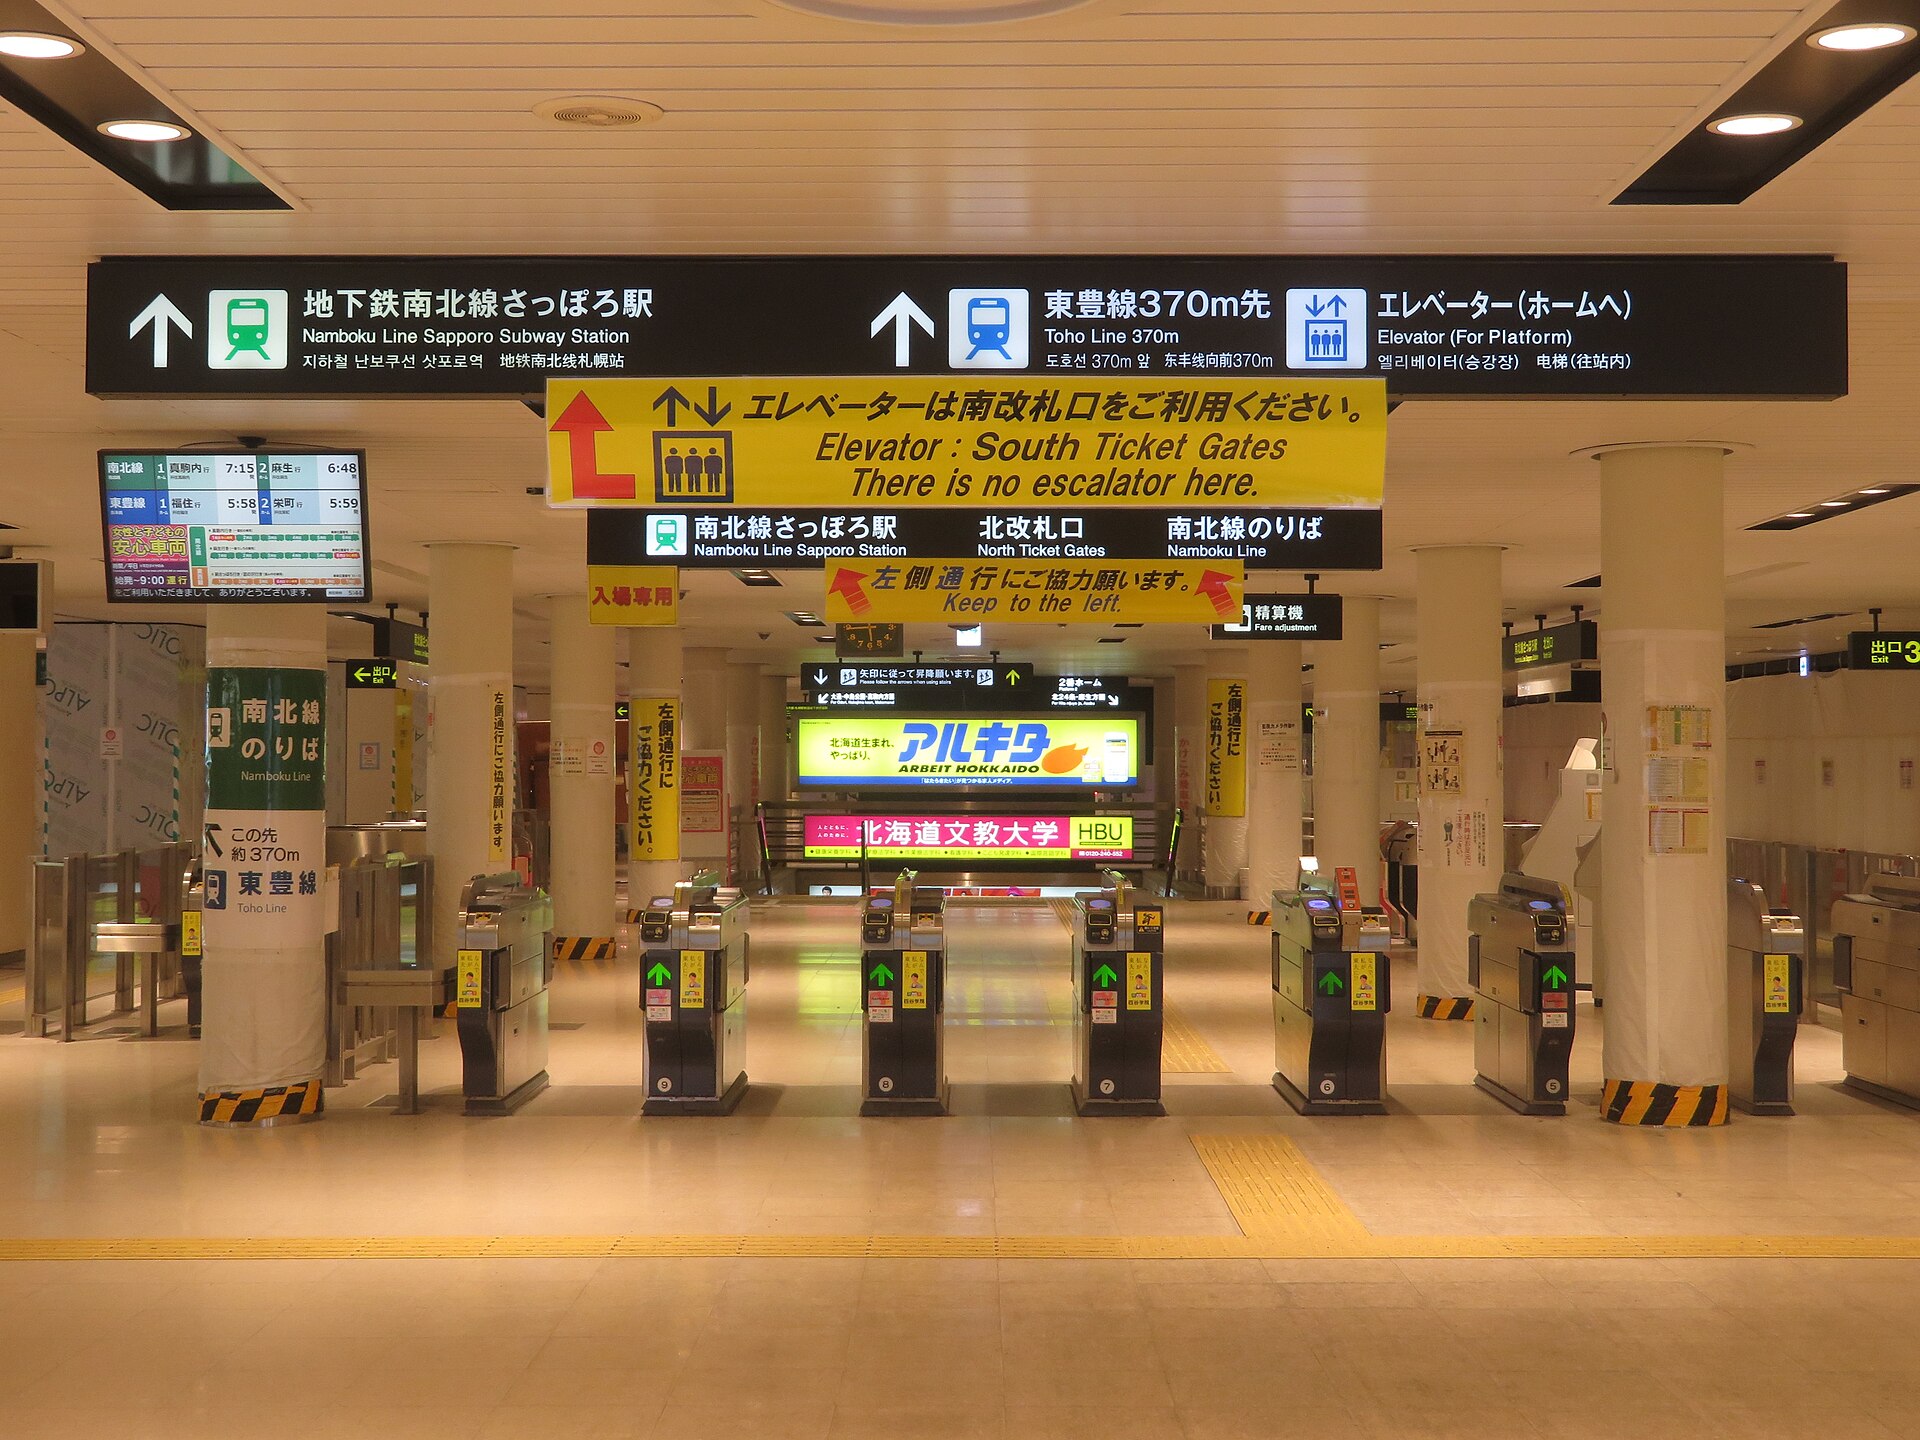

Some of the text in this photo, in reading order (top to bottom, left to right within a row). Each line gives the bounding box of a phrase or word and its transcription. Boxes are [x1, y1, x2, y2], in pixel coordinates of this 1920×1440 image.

[303, 288, 653, 319] 地下鉄南北線さっぽろ駅
[1044, 289, 1271, 319] 東豊線370m先
[1378, 290, 1631, 320] エレベーター(ホームへ)
[303, 328, 629, 347] Namboku Line Sapporo Subway Station
[1044, 328, 1179, 344] Toho Line 370m
[1378, 329, 1572, 348] Elevator (For Platform)
[302, 354, 483, 369] 지하철 난보쿠선 삿포로역
[499, 353, 625, 369] 地铁南北线札幌站
[1045, 353, 1151, 369] 도호선 370m 앞
[1164, 352, 1273, 369] 东丰线向前370m
[1378, 354, 1519, 370] 엘리베이터(승강장)
[742, 389, 1360, 423] エレベーターは南改札口をご利用ください。
[816, 432, 1288, 461] Elevator : South Ticket Gates
[107, 462, 144, 474] 南北線
[158, 463, 165, 473] 1
[226, 463, 254, 473] 7:15
[259, 463, 268, 473] 2
[327, 463, 357, 473] 6:48
[852, 467, 1258, 497] There is no escalator here.
[109, 497, 146, 509] 東豊線
[160, 499, 167, 508] 1
[227, 498, 257, 508] 5:58
[261, 498, 270, 508] 2
[329, 498, 359, 508] 5:59
[112, 527, 185, 537] 女性と子どもの
[694, 515, 897, 540] 南北線さっぽろ駅
[979, 515, 1083, 540] 北改札口
[1167, 515, 1323, 540] 南北線のりば
[112, 538, 186, 556] 安心車両
[694, 543, 907, 559] Namboku Line Sapporo Station
[978, 544, 1106, 557] North Ticket Gates
[1168, 544, 1267, 557] Namboku Line
[870, 565, 1190, 592] 左側通行にご協力願います。
[591, 586, 673, 606] 入場専用
[943, 592, 1122, 614] Keep to the left.
[1255, 604, 1304, 621] 精算機
[1254, 623, 1317, 633] Fare adjustment
[1871, 640, 1920, 663] 出口 3
[1871, 655, 1889, 663] Exit
[372, 666, 391, 677] 出口
[859, 668, 975, 679] 矢印に従って昇降願います。
[241, 697, 320, 725] 南北線
[1227, 683, 1242, 757] 左側通行に
[241, 736, 319, 761] のりば
[658, 702, 674, 788] 左側通行に
[829, 737, 895, 749] 北海道生まれ、
[898, 721, 1051, 763] アルキタ
[830, 750, 871, 761] やっぱり、
[1209, 702, 1223, 811] ご協力ください。
[241, 771, 311, 781] Namboku Line
[898, 764, 1040, 774] ARBEIT HOKKAIDO
[637, 725, 653, 854] ご協力ください。
[231, 827, 278, 843] この先
[856, 820, 1059, 846] 北海道文教大学
[1079, 823, 1123, 840] HBU
[238, 869, 317, 896] 東豊線
[237, 903, 287, 913] Toho Line
[661, 1081, 668, 1089] 9
[882, 1080, 889, 1089] 8
[1104, 1082, 1111, 1090] 7
[1323, 1083, 1331, 1091] 6
[1549, 1082, 1557, 1090] 5
